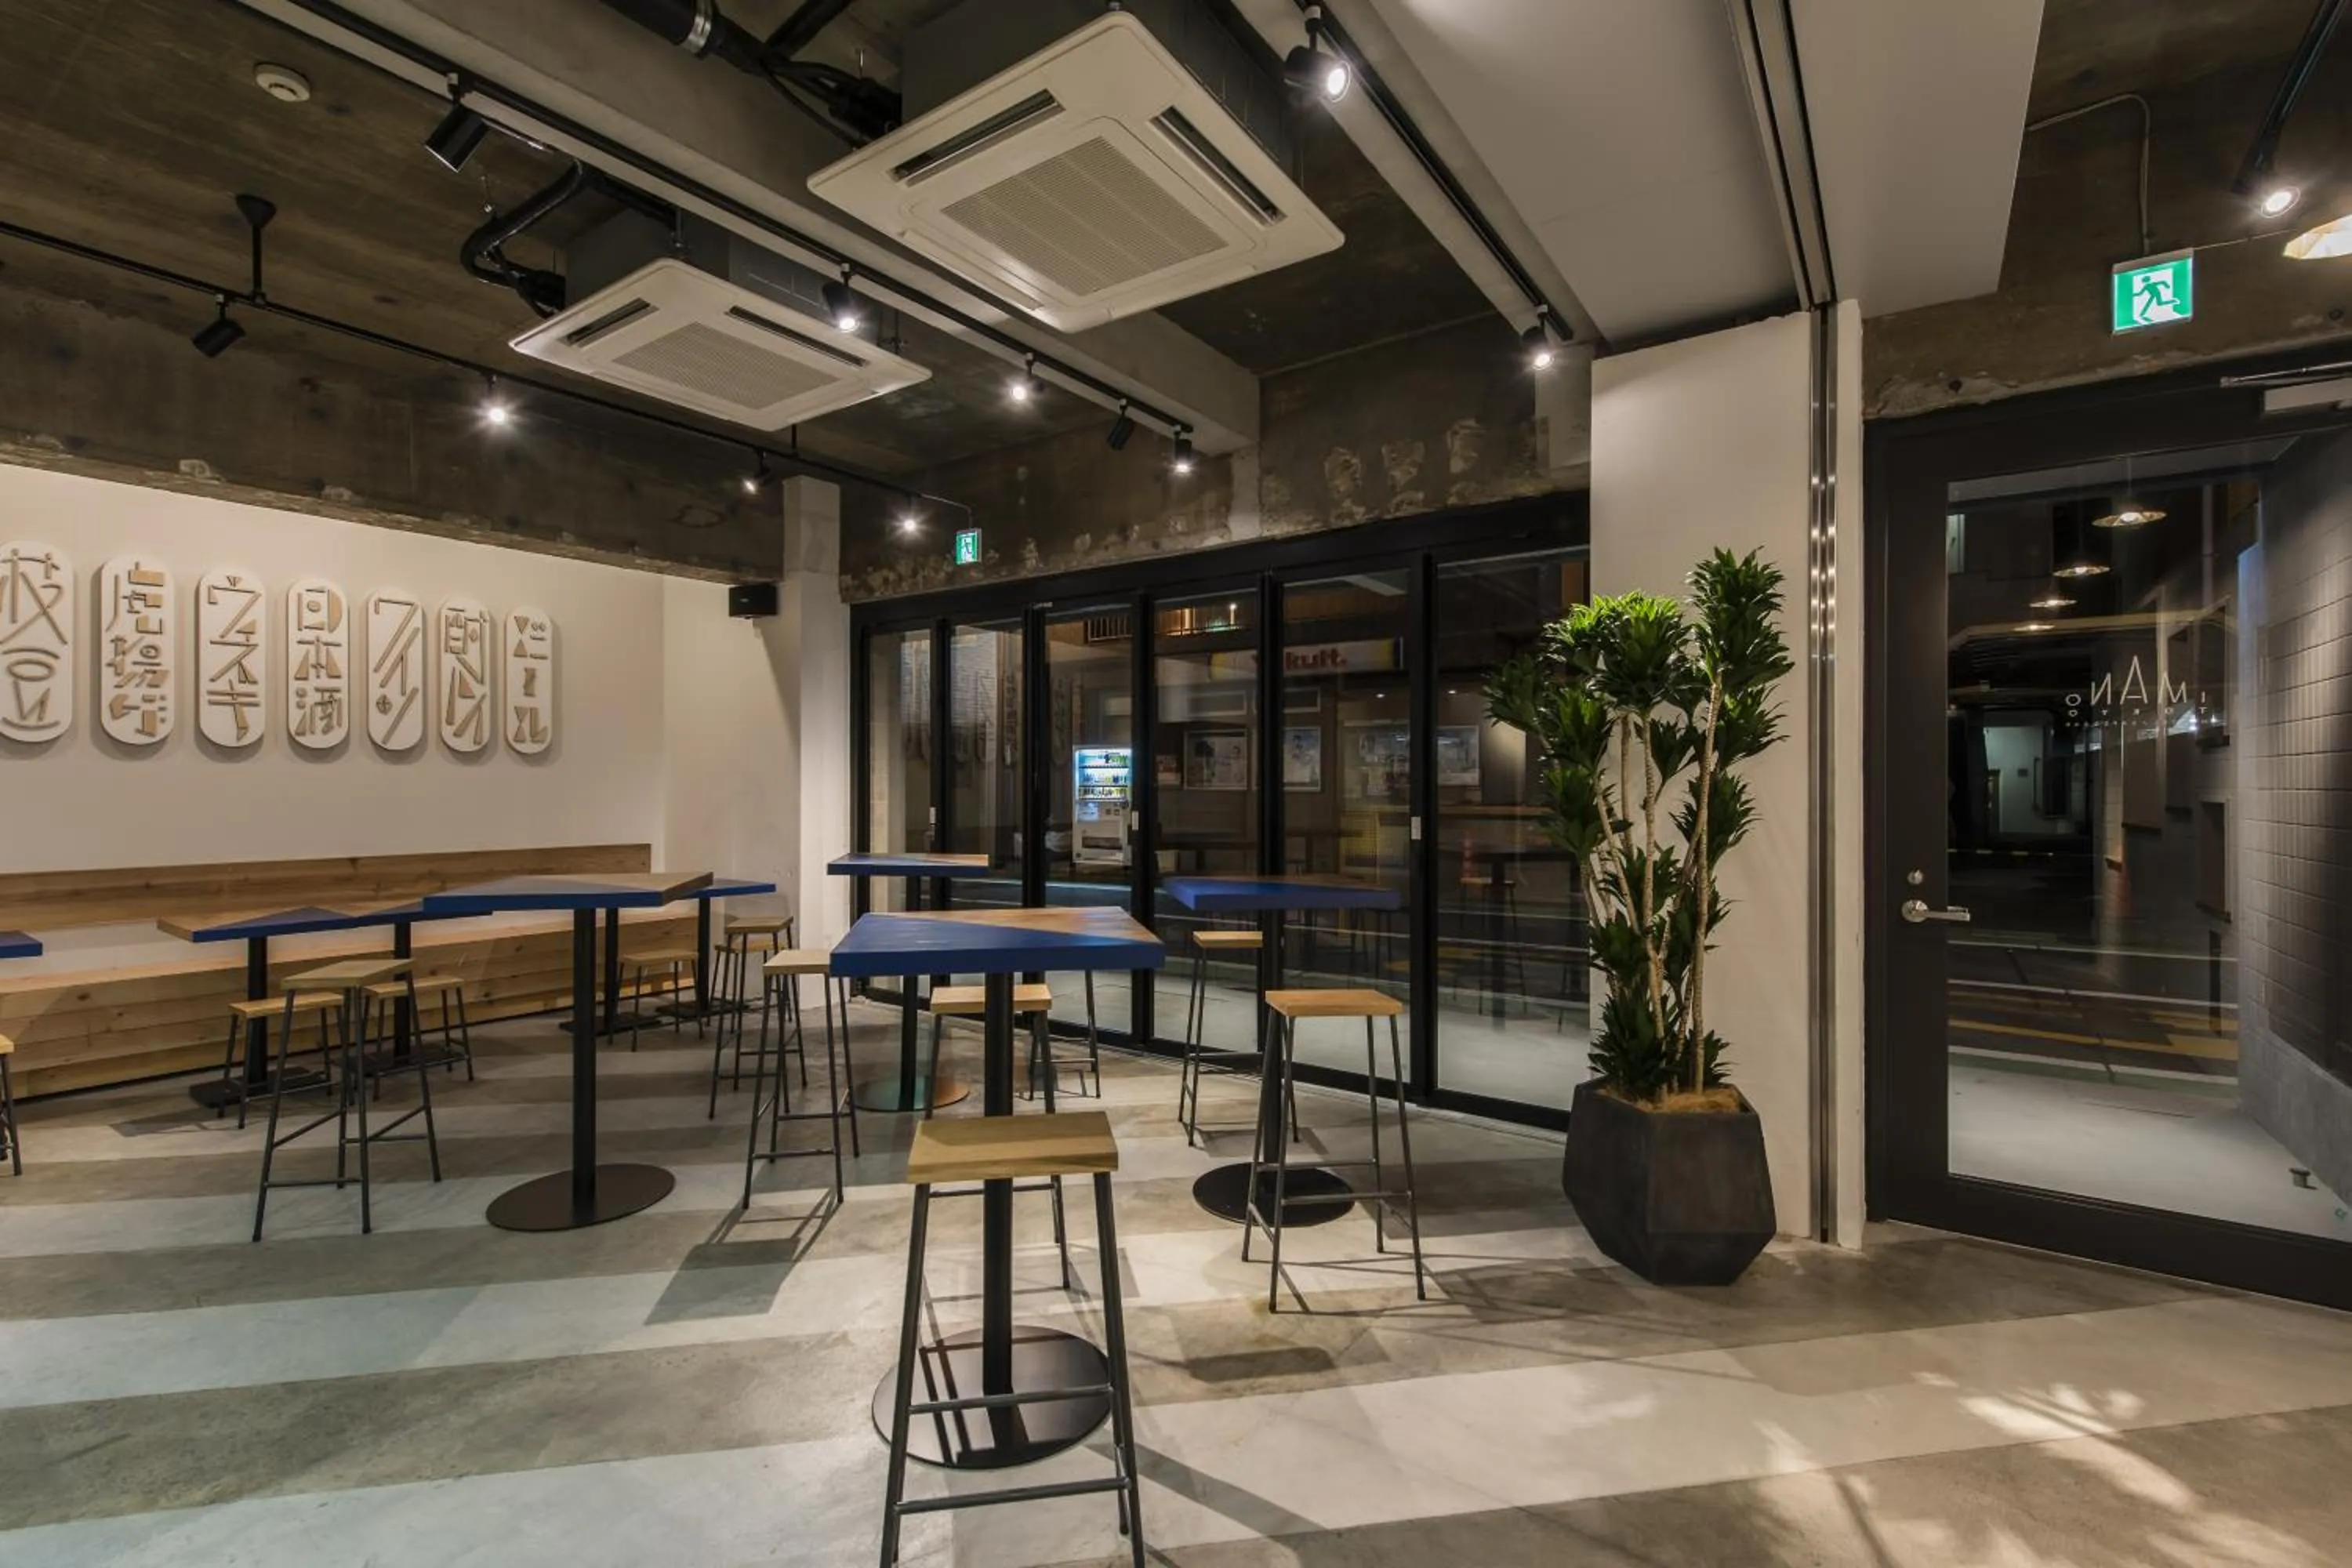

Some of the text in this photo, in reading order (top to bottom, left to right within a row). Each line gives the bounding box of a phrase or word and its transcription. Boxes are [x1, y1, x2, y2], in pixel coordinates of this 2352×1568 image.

[294, 585, 343, 737] 日本酒
[513, 615, 549, 744] ビール
